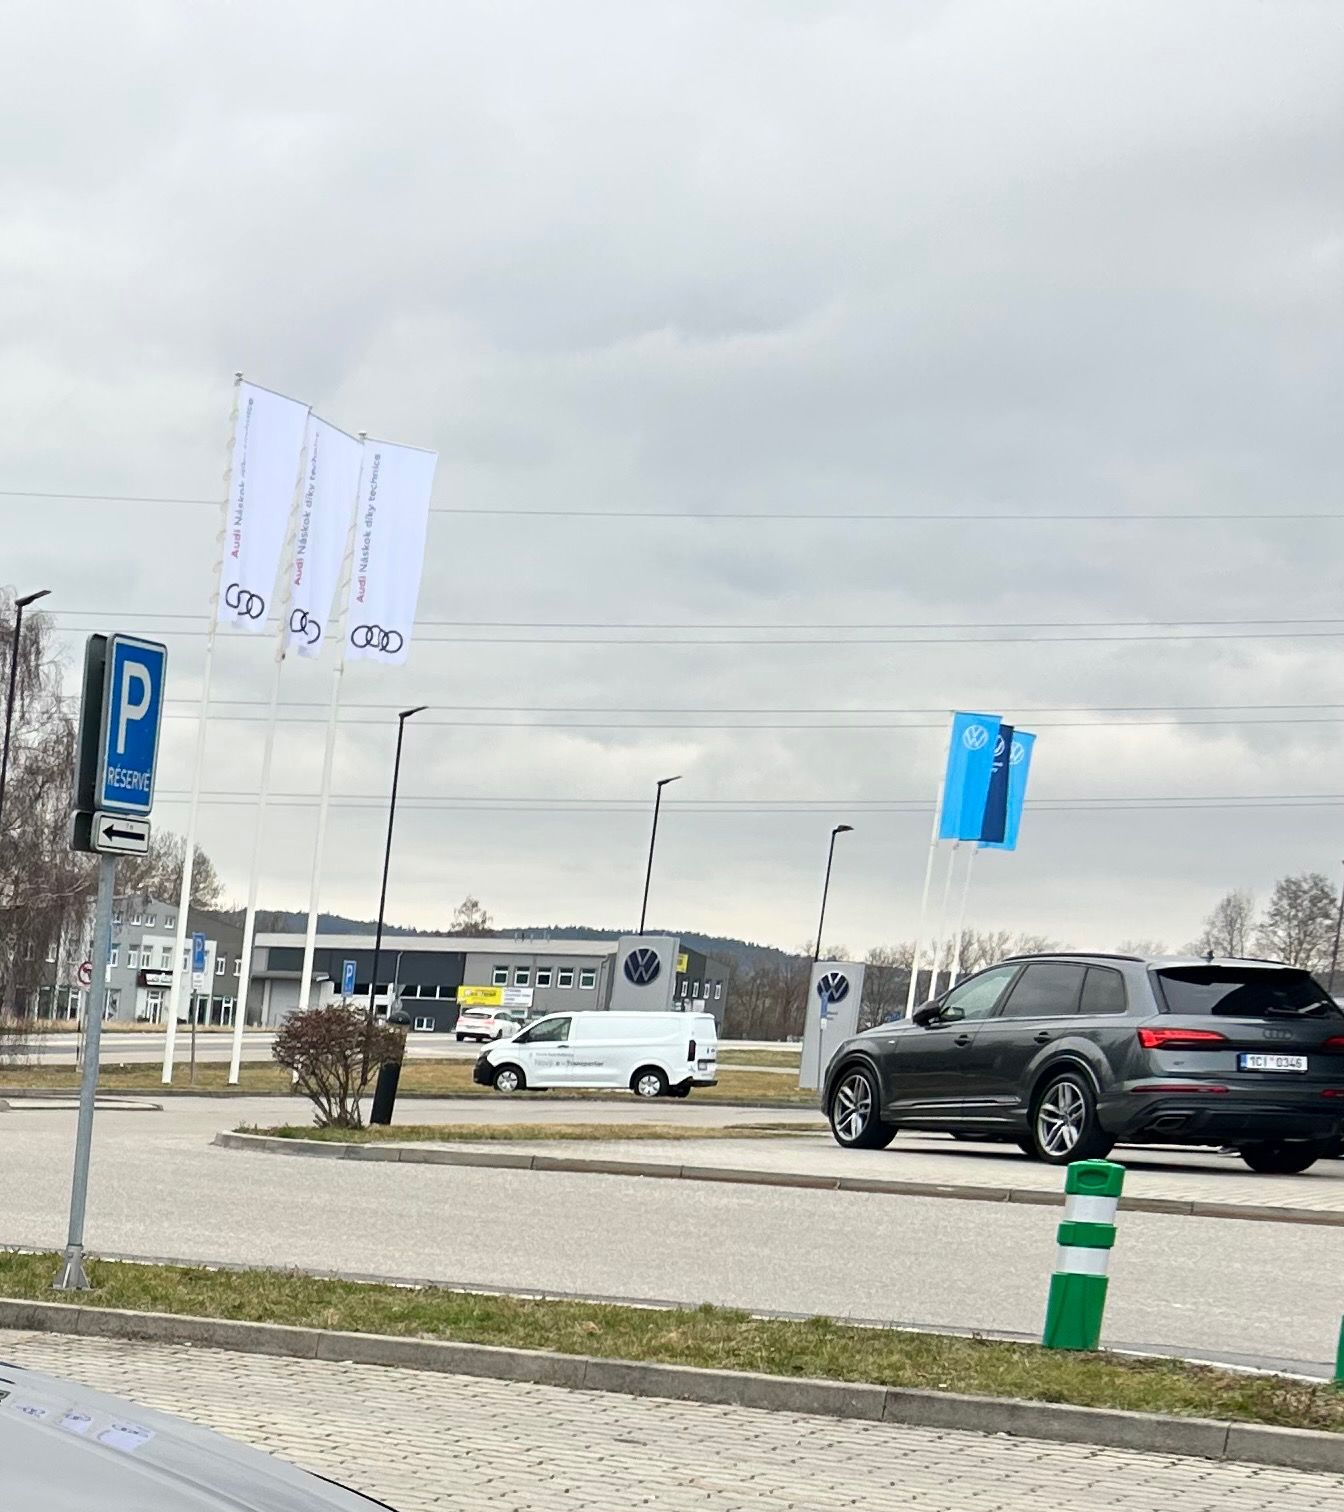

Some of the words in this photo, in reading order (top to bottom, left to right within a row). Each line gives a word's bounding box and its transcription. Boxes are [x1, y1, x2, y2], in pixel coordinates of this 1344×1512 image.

[368, 453, 381, 501] technice
[366, 503, 377, 527] díky
[231, 529, 241, 559] Audi
[297, 509, 311, 555] Náskok
[359, 529, 372, 573] Náskok
[294, 557, 305, 586] Audi
[356, 575, 367, 603] Audi
[117, 660, 152, 754] P
[107, 763, 151, 792] RÉSERVÉ
